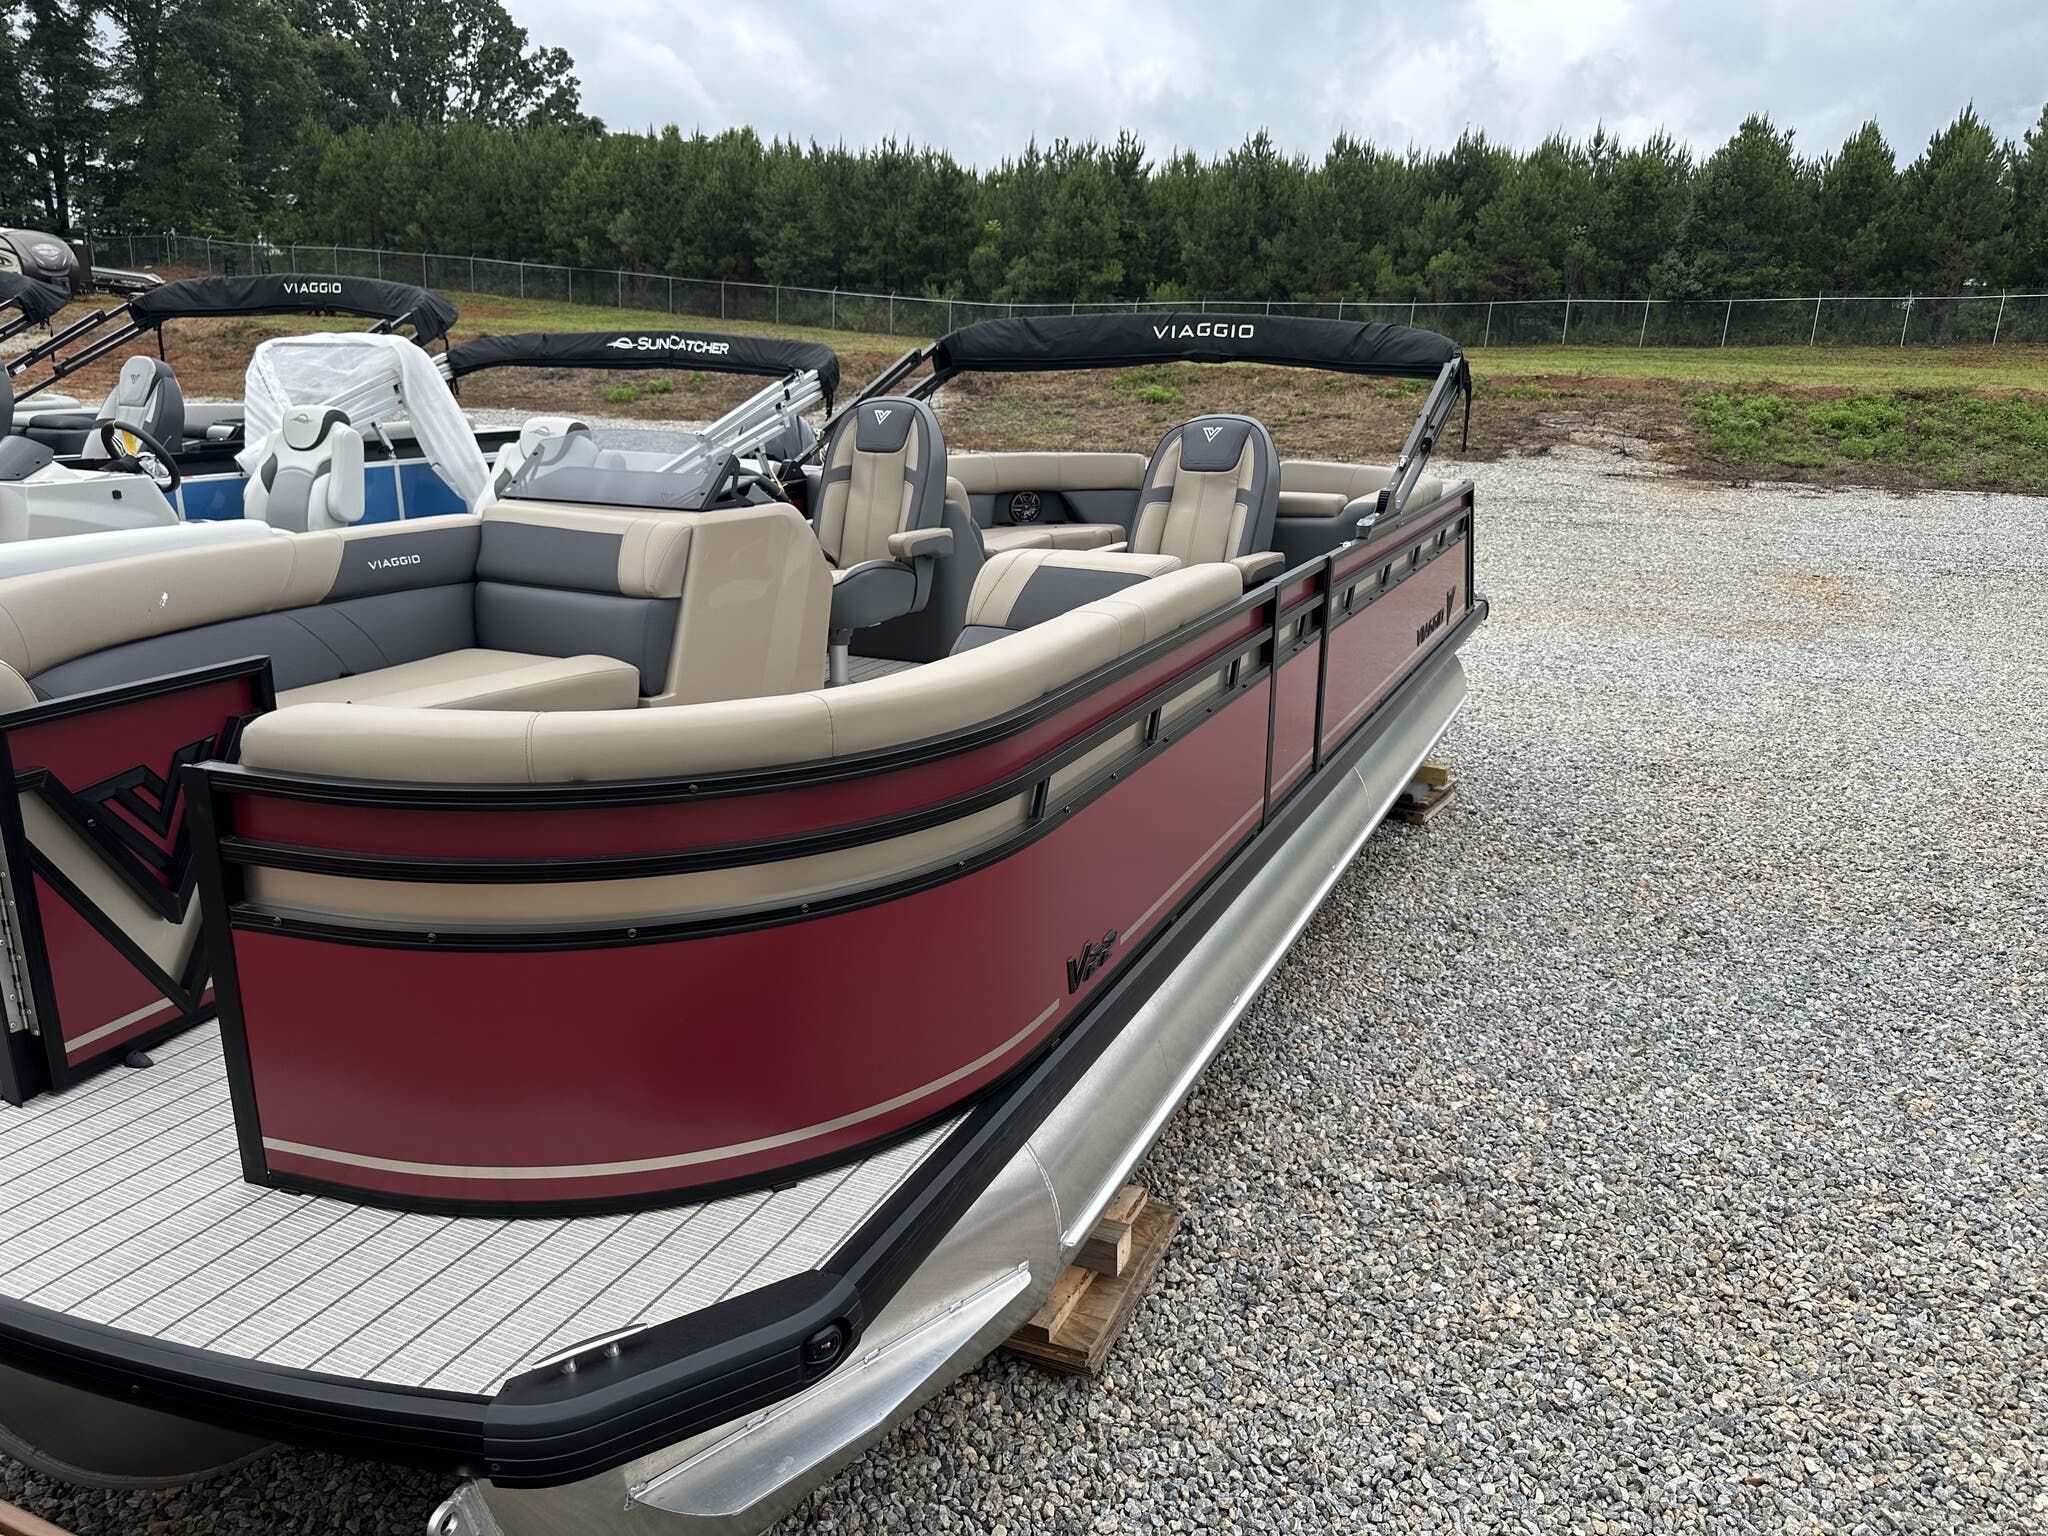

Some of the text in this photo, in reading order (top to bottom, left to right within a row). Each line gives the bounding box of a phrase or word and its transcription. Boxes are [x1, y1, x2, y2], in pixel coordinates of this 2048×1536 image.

[284, 282, 342, 294] VIAGGIO
[1153, 323, 1254, 340] VIAGGIO
[368, 555, 421, 570] VIAGGIO
